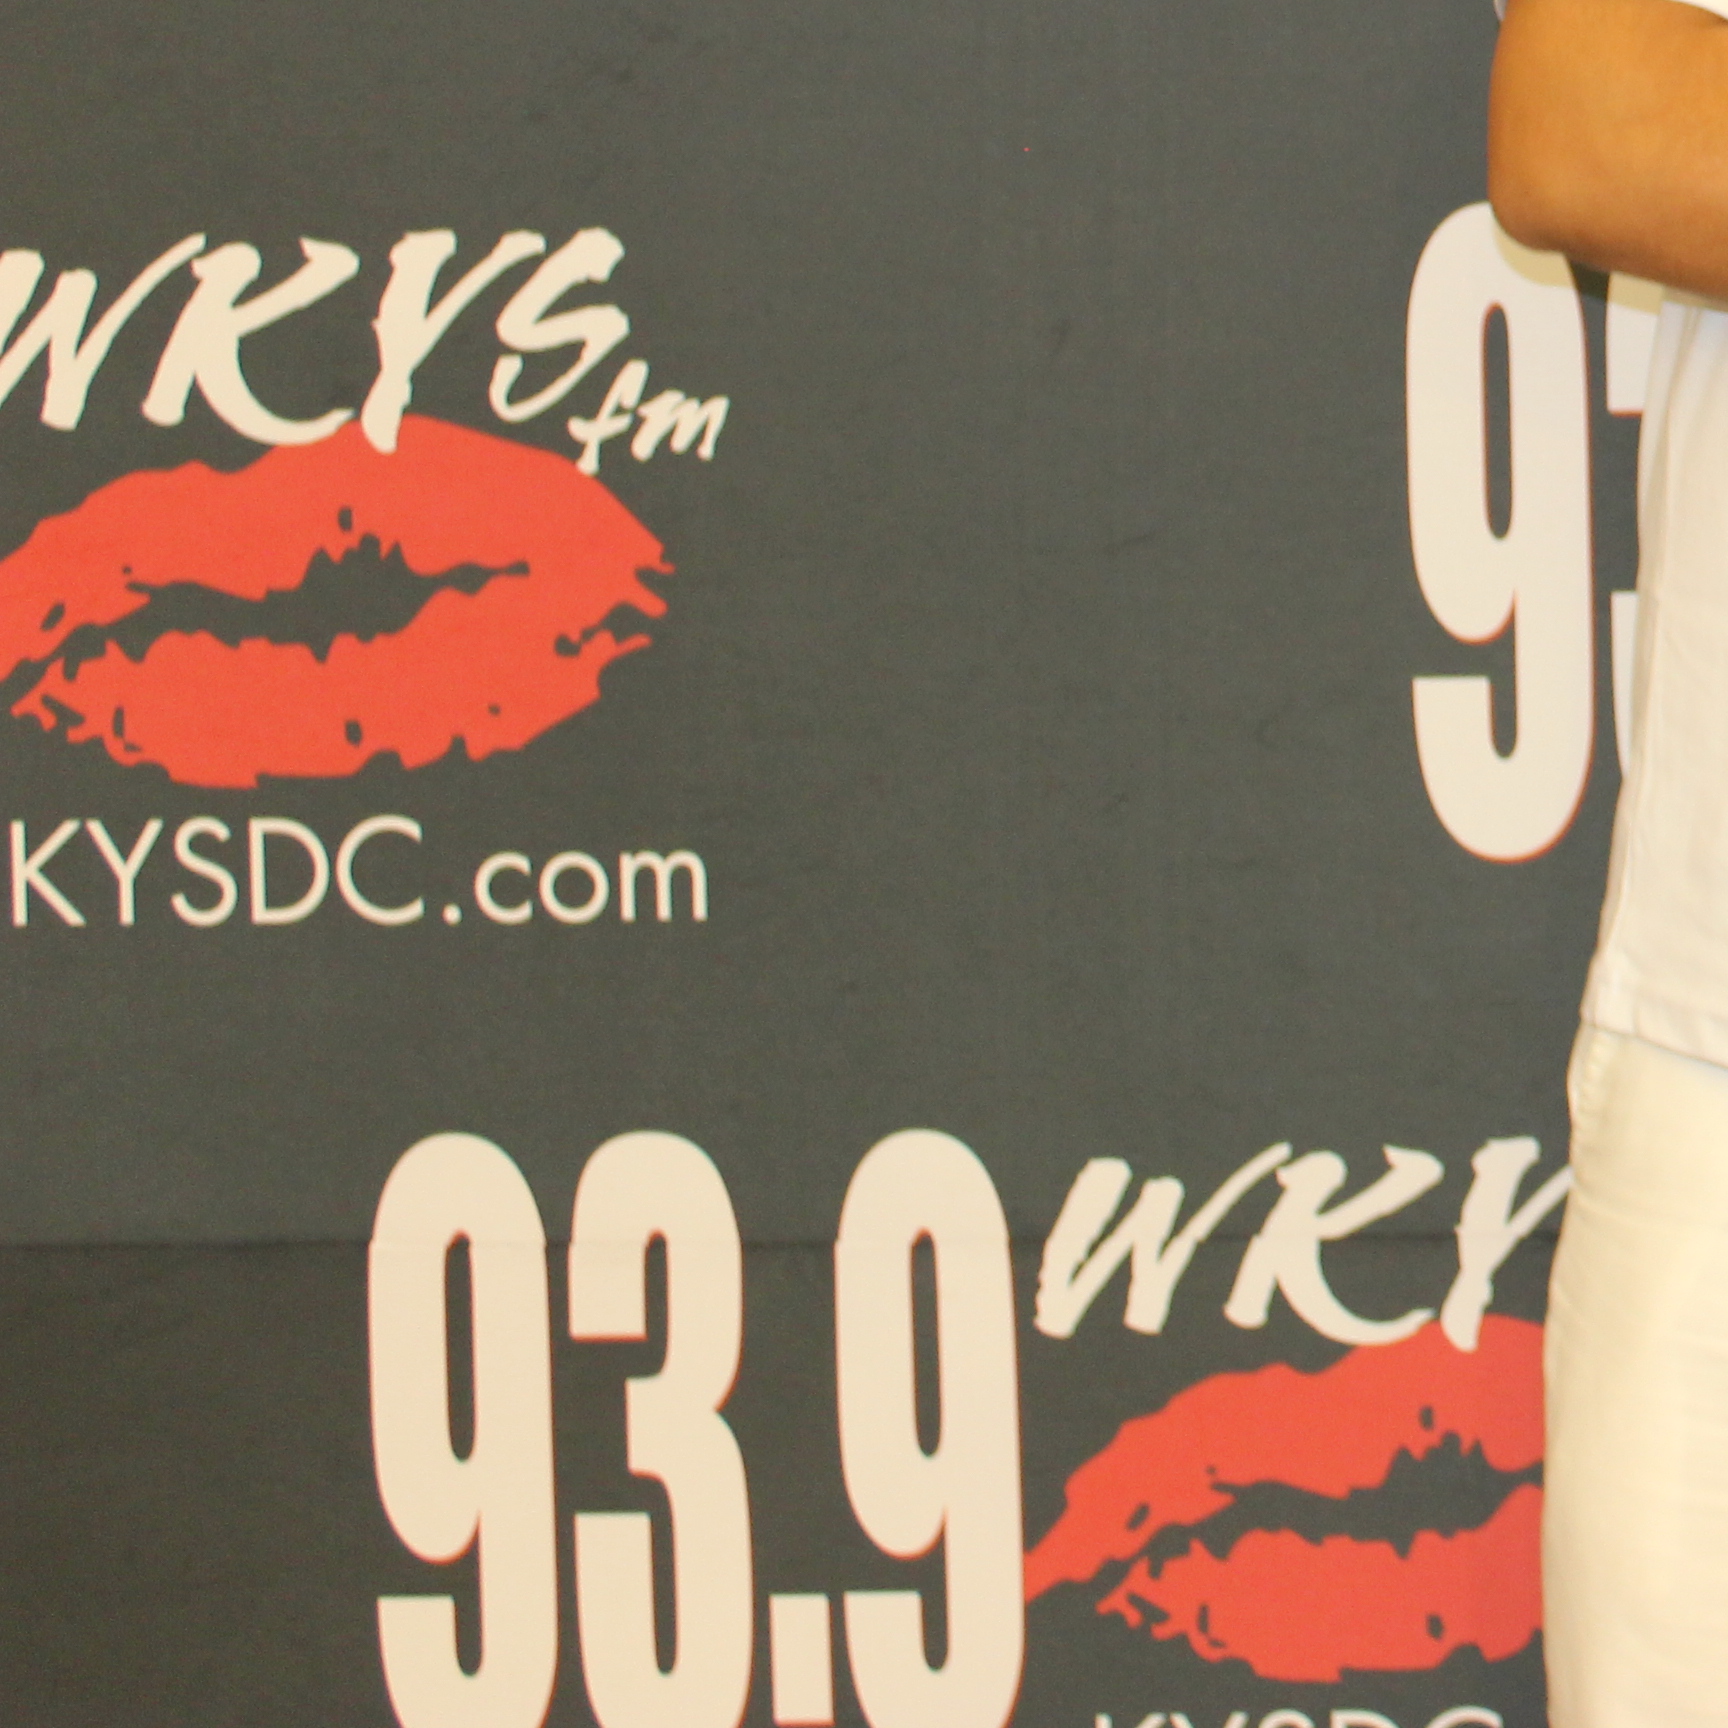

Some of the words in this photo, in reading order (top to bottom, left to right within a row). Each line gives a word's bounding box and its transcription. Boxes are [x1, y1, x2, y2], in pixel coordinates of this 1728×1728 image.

[569, 361, 729, 474] fm
[11, 816, 707, 925] KYSDC.com
[369, 1130, 1023, 1728] 93.9
